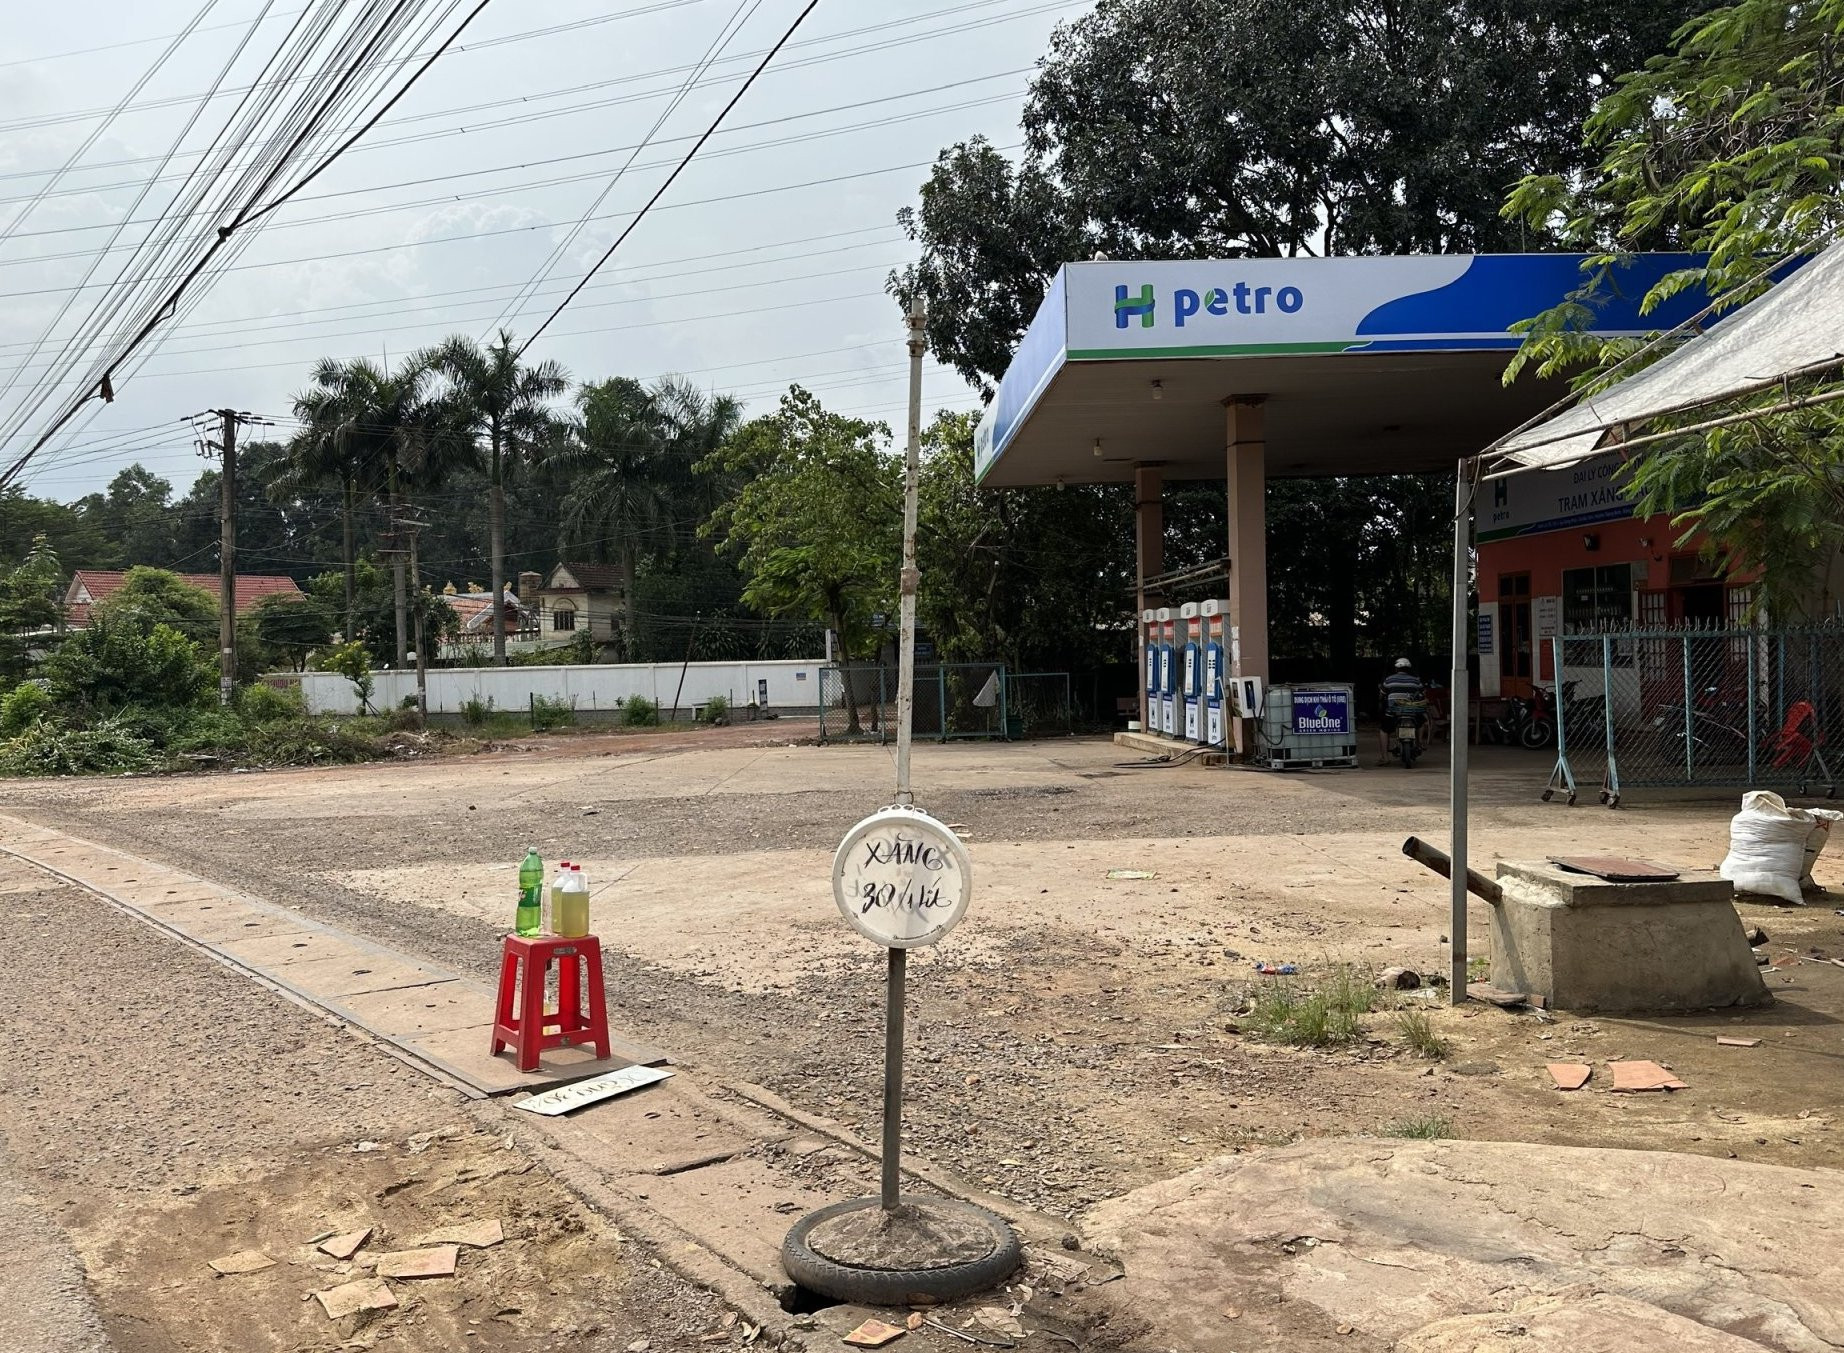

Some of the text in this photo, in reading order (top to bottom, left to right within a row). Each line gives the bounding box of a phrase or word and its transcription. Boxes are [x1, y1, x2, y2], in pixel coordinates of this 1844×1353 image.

[1114, 282, 1304, 329] H petro
[1298, 717, 1341, 728] BlueOne
[863, 832, 944, 871] XĂNG
